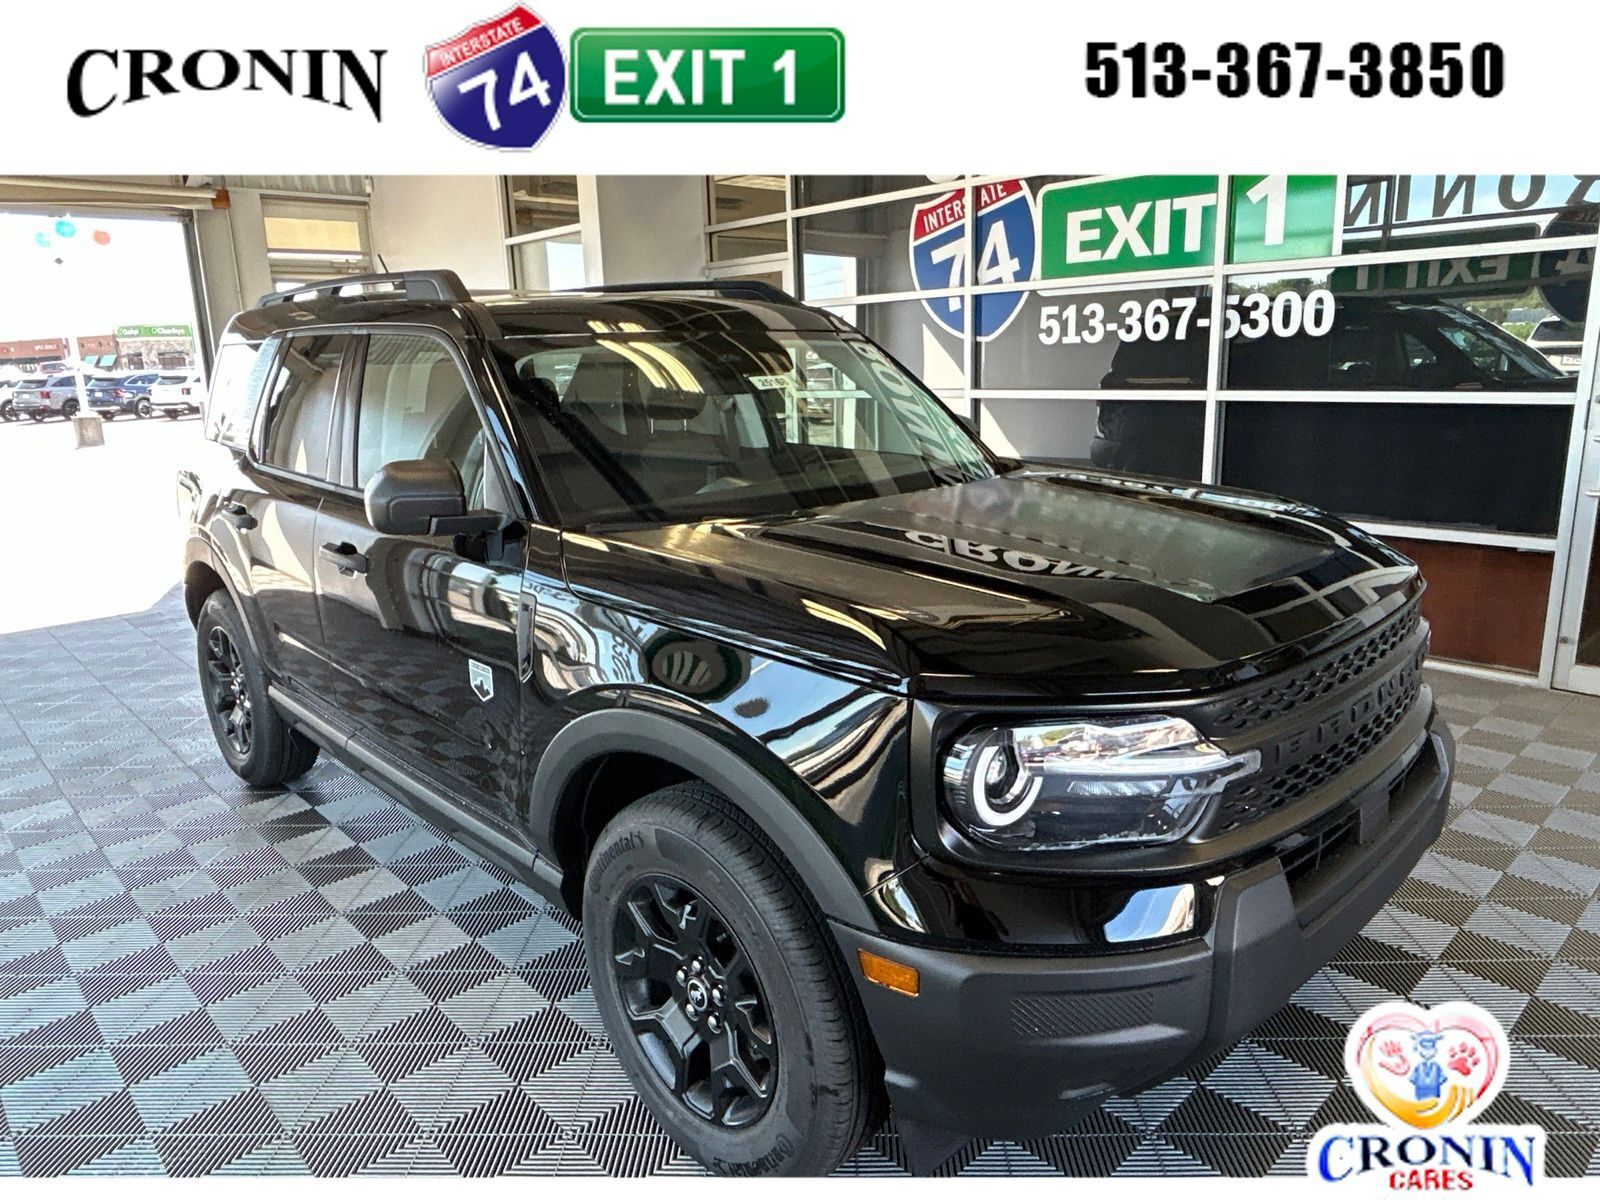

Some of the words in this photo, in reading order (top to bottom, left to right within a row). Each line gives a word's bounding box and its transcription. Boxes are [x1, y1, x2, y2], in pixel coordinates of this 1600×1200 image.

[1066, 193, 1217, 264] EXIT
[1246, 174, 1288, 246] 1
[931, 220, 1021, 313] 74
[1038, 289, 1336, 346] 513-367-5300
